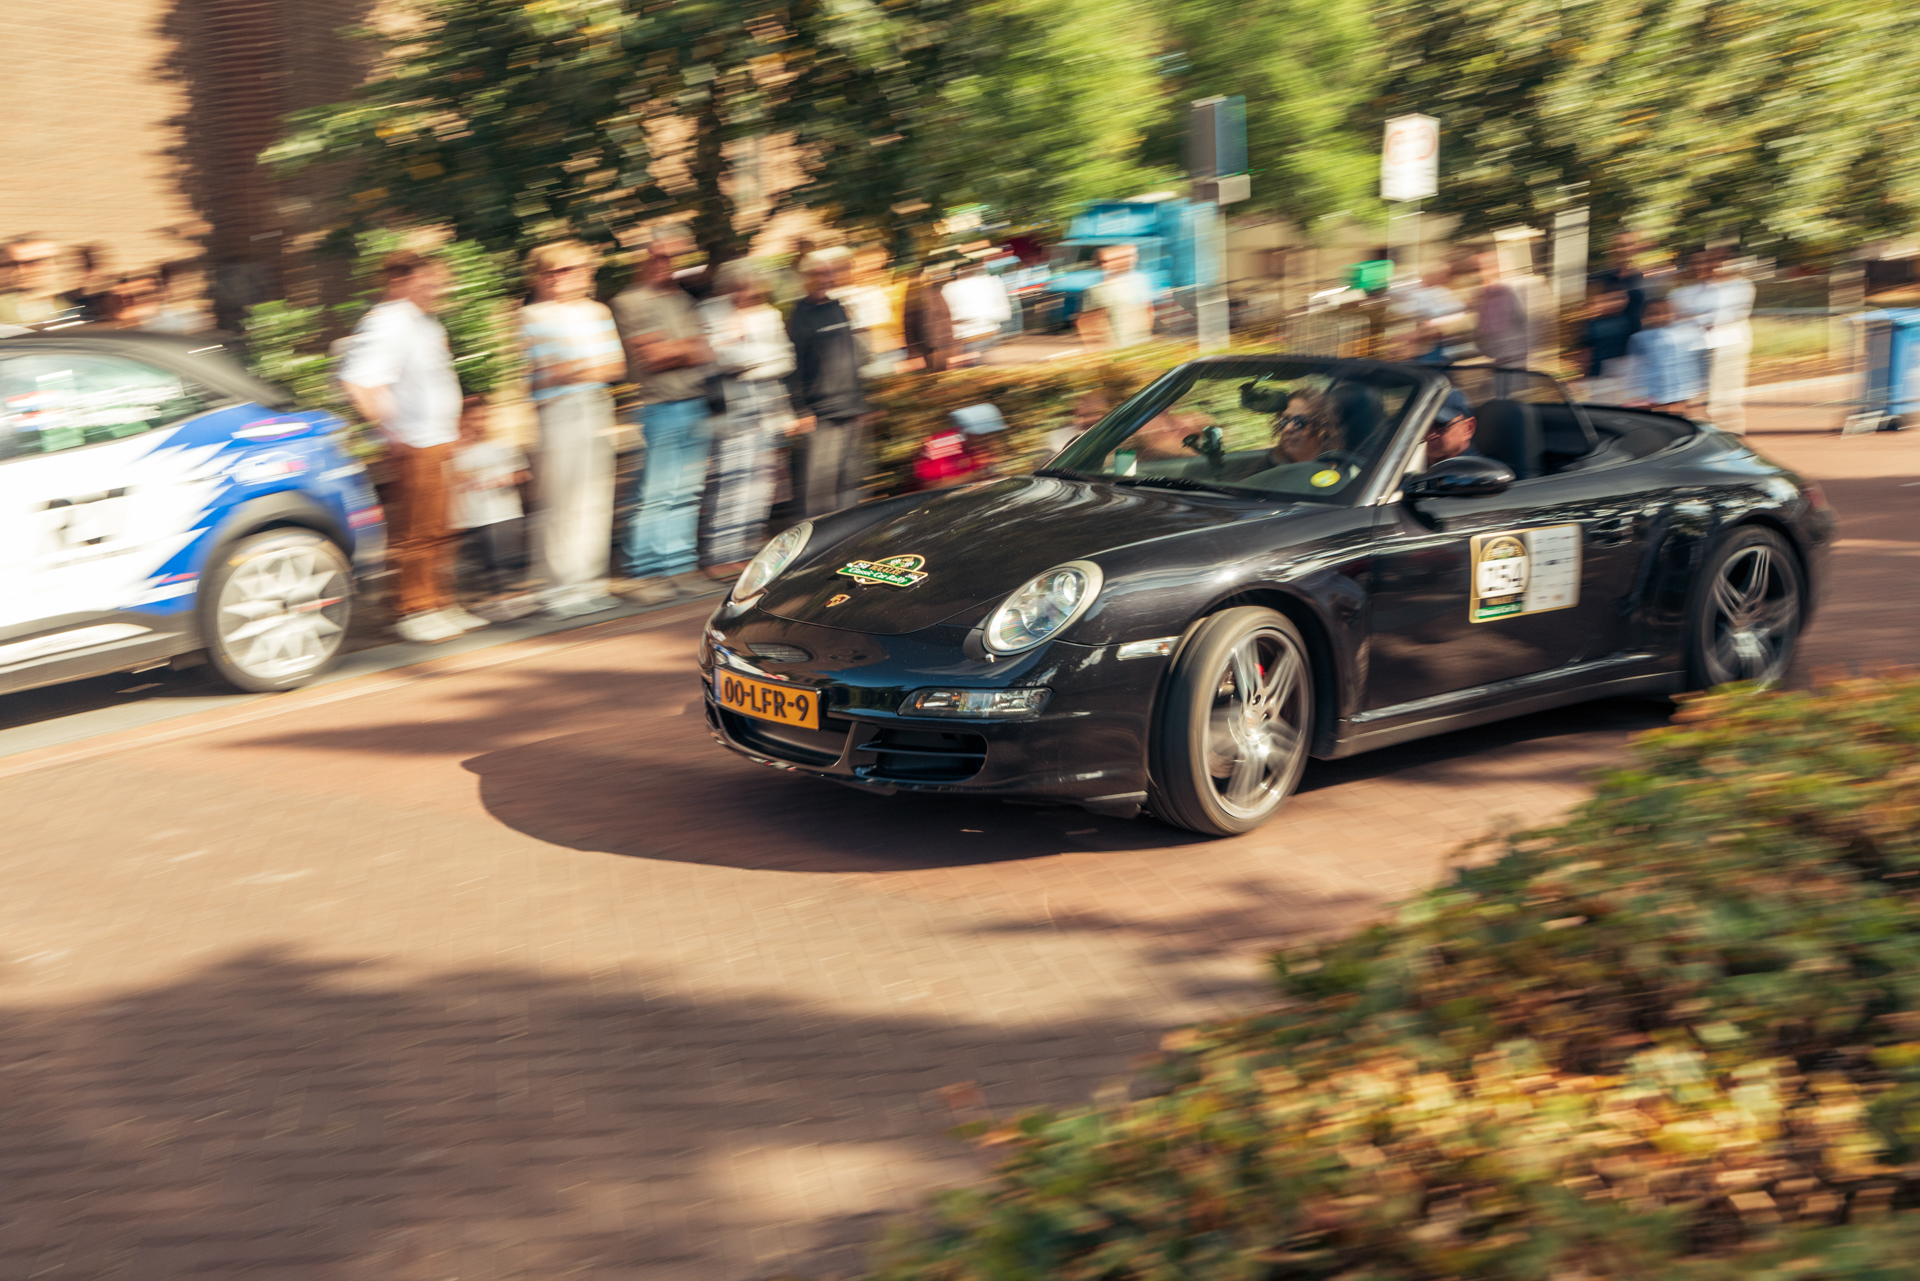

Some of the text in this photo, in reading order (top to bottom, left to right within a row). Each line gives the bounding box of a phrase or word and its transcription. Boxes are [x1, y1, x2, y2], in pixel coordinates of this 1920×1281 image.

[848, 567, 873, 576] Classic
[886, 575, 907, 584] Rally
[724, 676, 809, 722] 00-LFR-9
